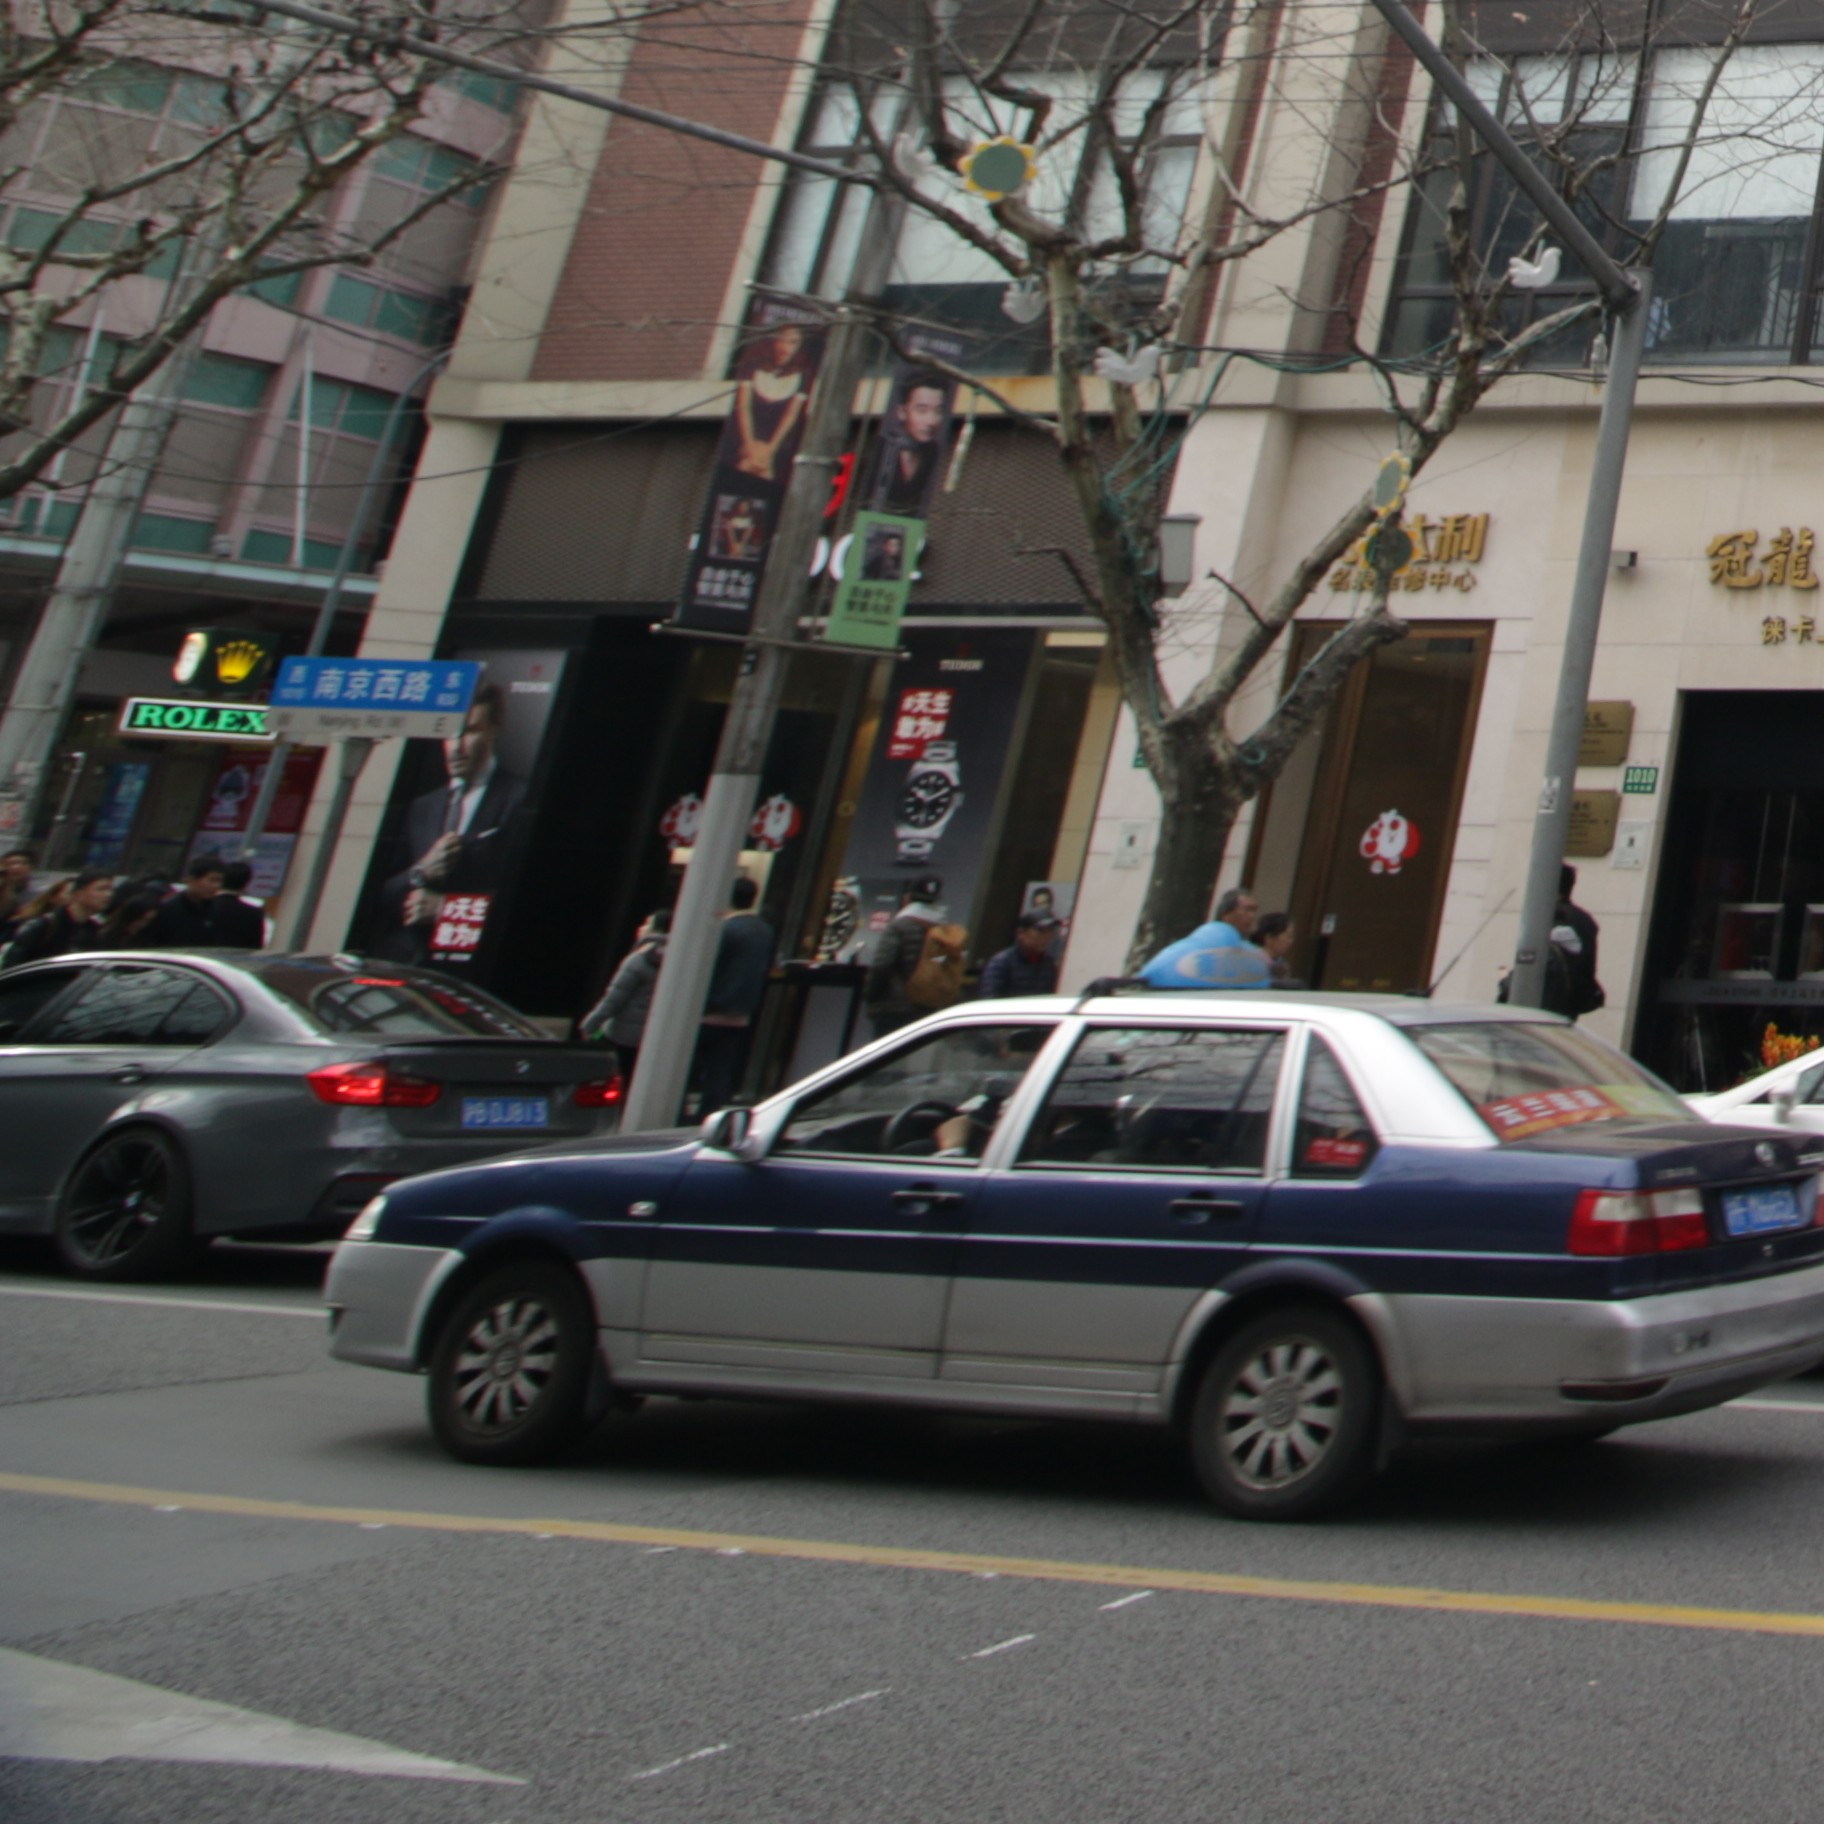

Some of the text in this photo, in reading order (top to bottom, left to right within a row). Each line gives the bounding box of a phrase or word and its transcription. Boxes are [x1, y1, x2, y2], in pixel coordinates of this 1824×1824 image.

[312, 667, 434, 704] 南京西路
[133, 703, 269, 733] ROLEX
[1626, 768, 1657, 784] 1010
